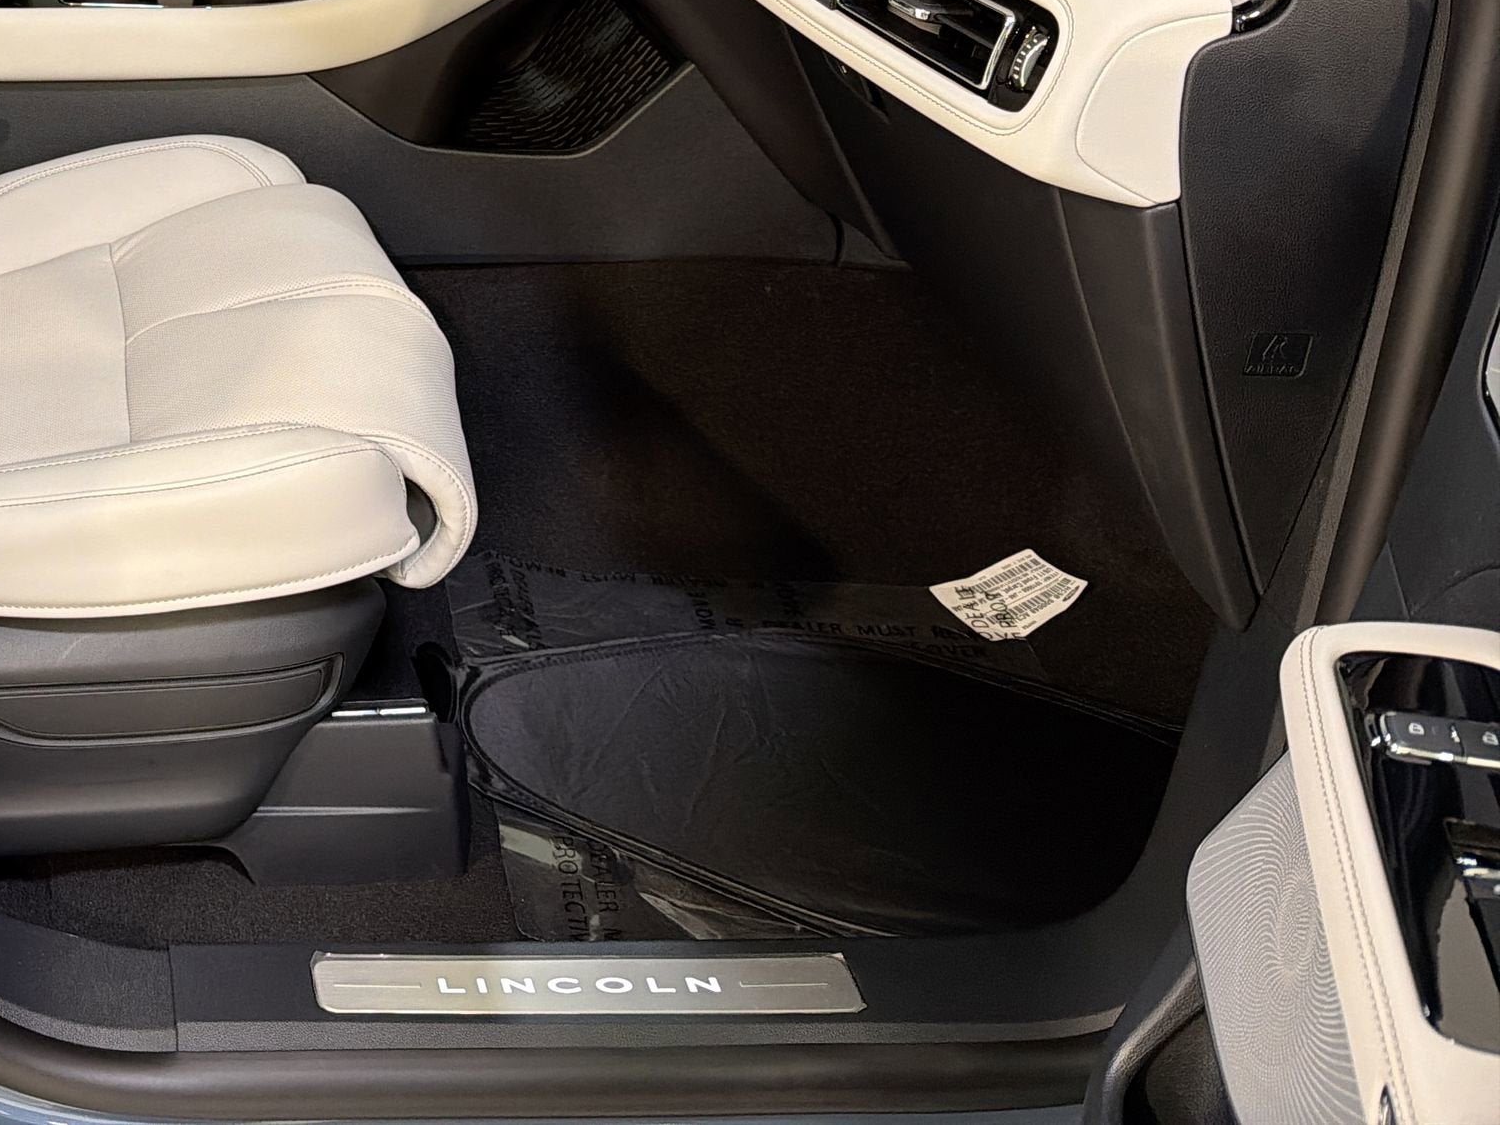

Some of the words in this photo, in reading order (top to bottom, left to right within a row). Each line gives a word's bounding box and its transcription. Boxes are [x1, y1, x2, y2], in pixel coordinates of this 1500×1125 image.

[857, 625, 917, 637] MUST
[551, 834, 591, 941] PROTECTIV
[437, 976, 723, 994] LINCOLN
